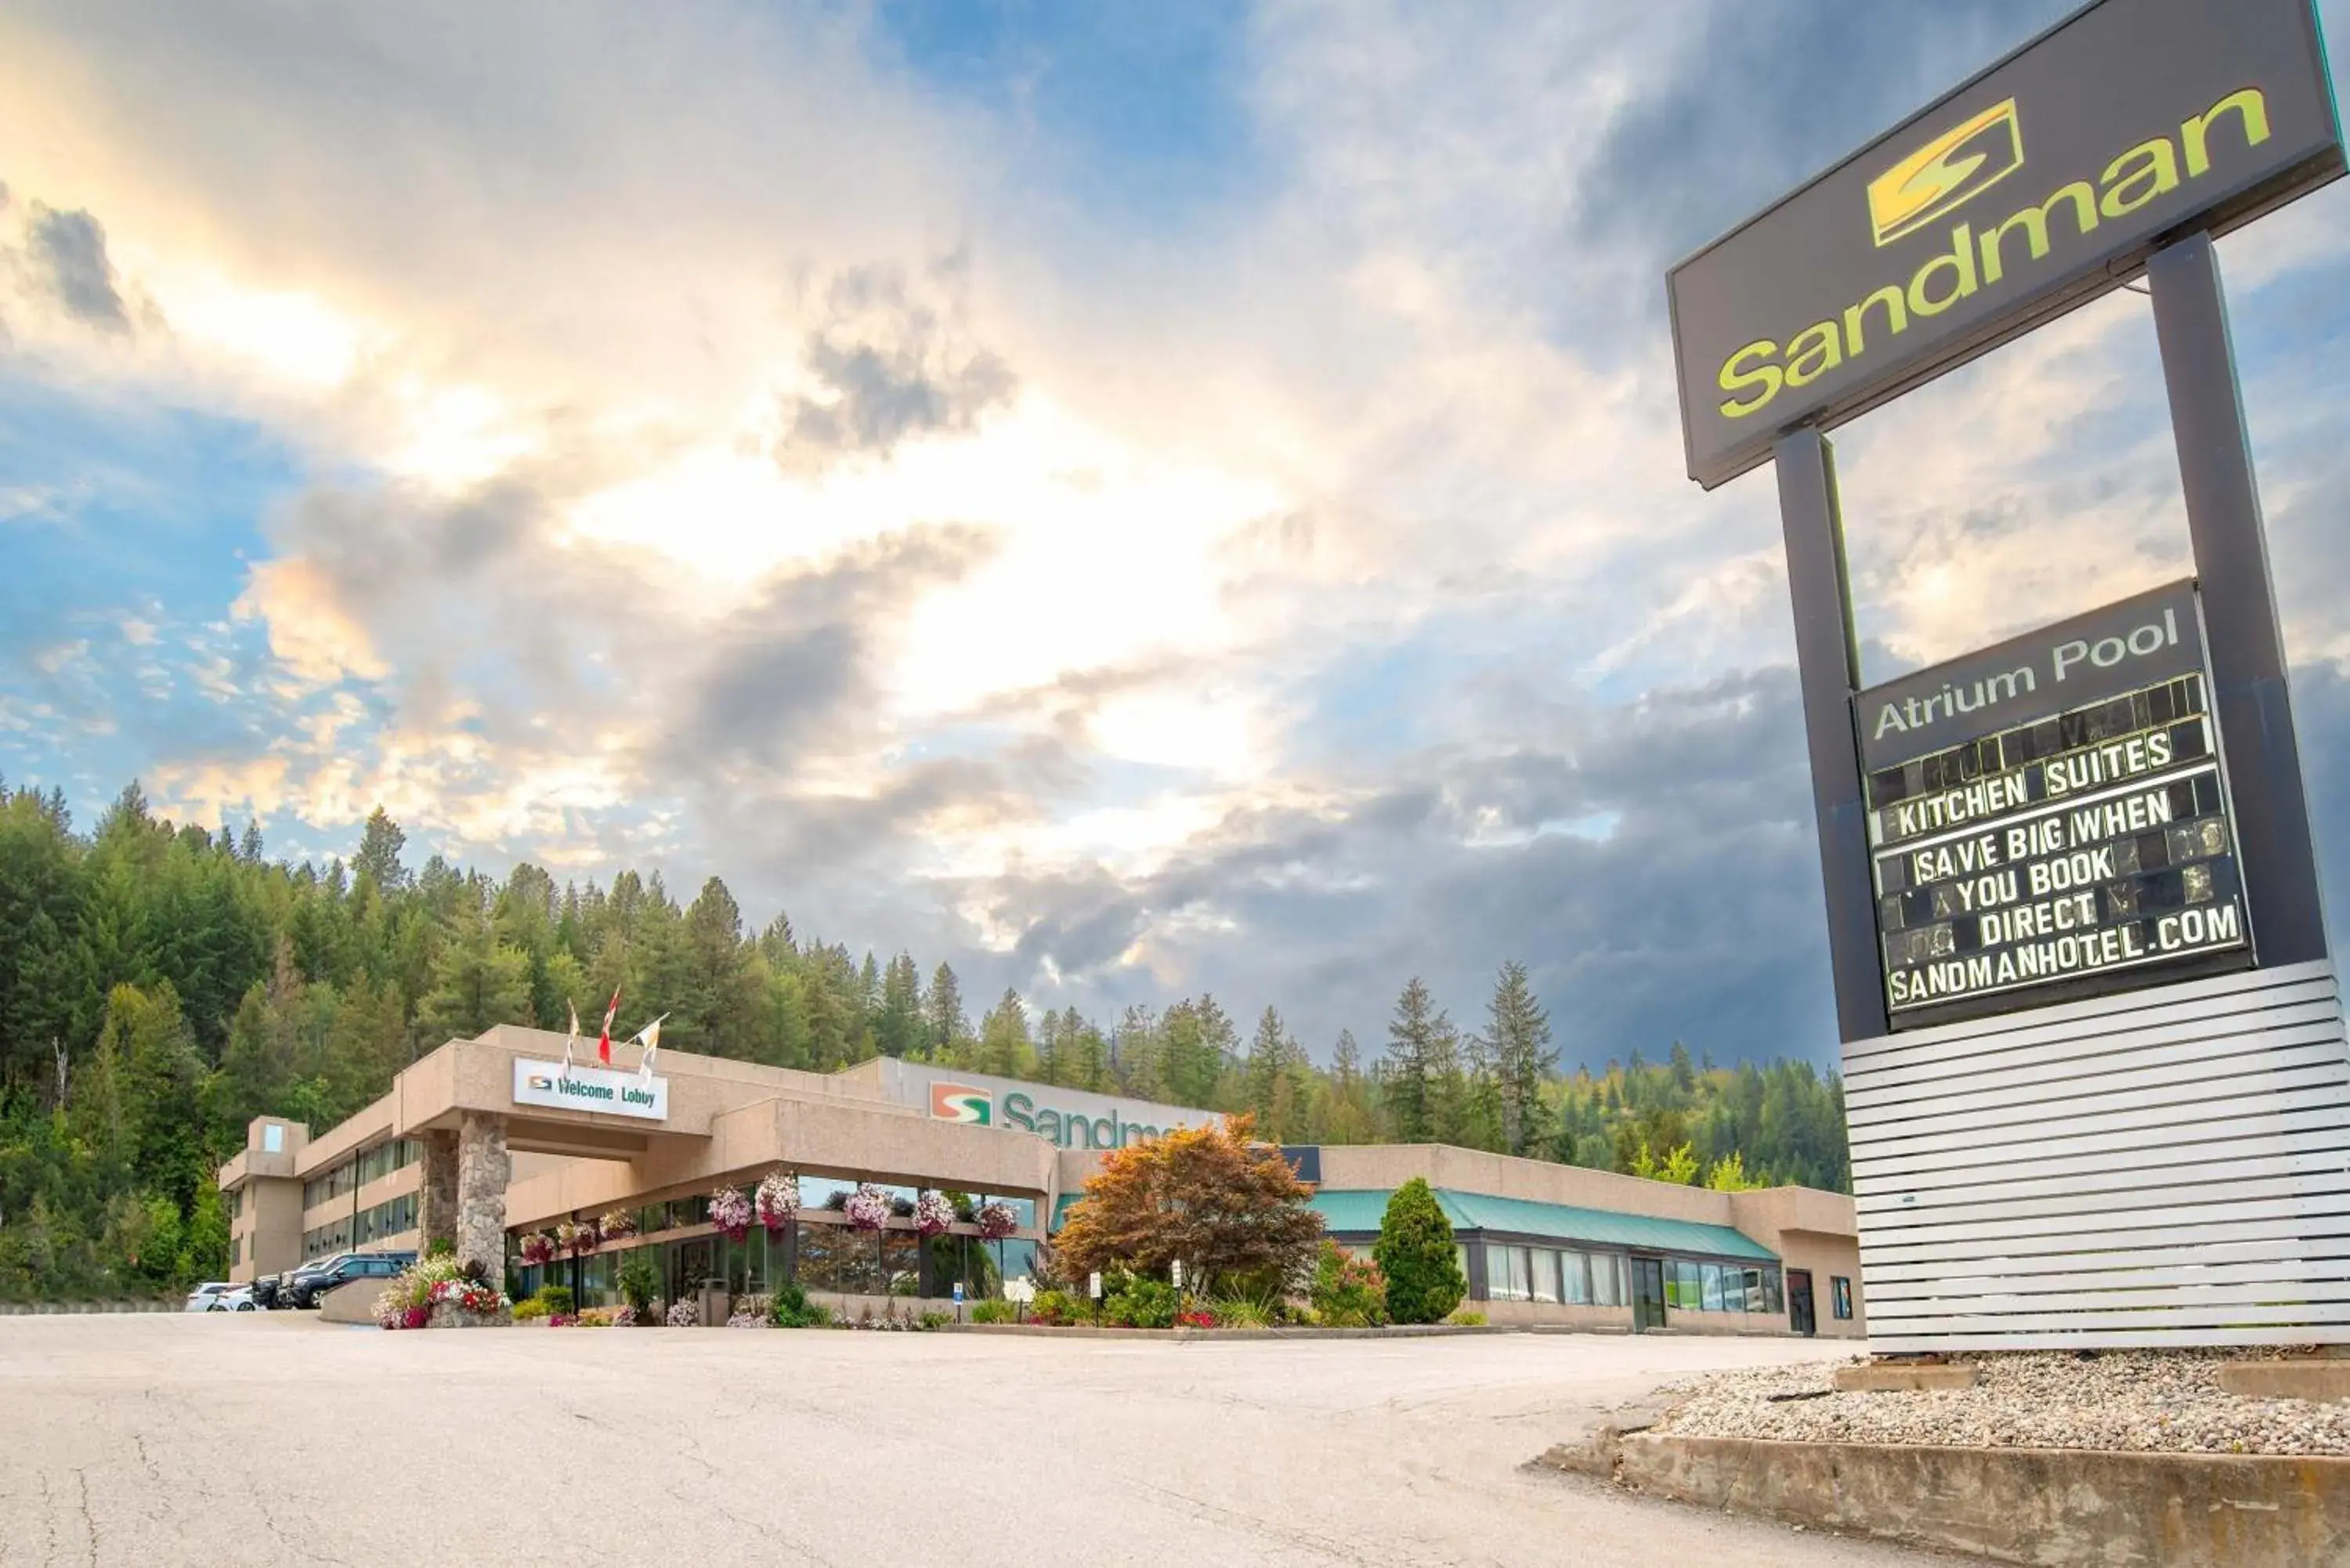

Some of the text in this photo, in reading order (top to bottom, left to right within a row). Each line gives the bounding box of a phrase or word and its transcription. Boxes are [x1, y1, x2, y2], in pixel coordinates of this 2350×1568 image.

[1719, 86, 2272, 417] Sandman
[1874, 609, 2179, 740] Atrium Pool
[1899, 732, 2171, 836] KITCHEN SUITES
[1918, 790, 2171, 882] SAVE BIG WHEN
[1957, 847, 2114, 911] YOU BOOK
[1889, 905, 2238, 1001] SANDMANHOTEL.COM
[1980, 892, 2095, 947] DIRECT
[558, 1077, 656, 1109] Welcome Lobby
